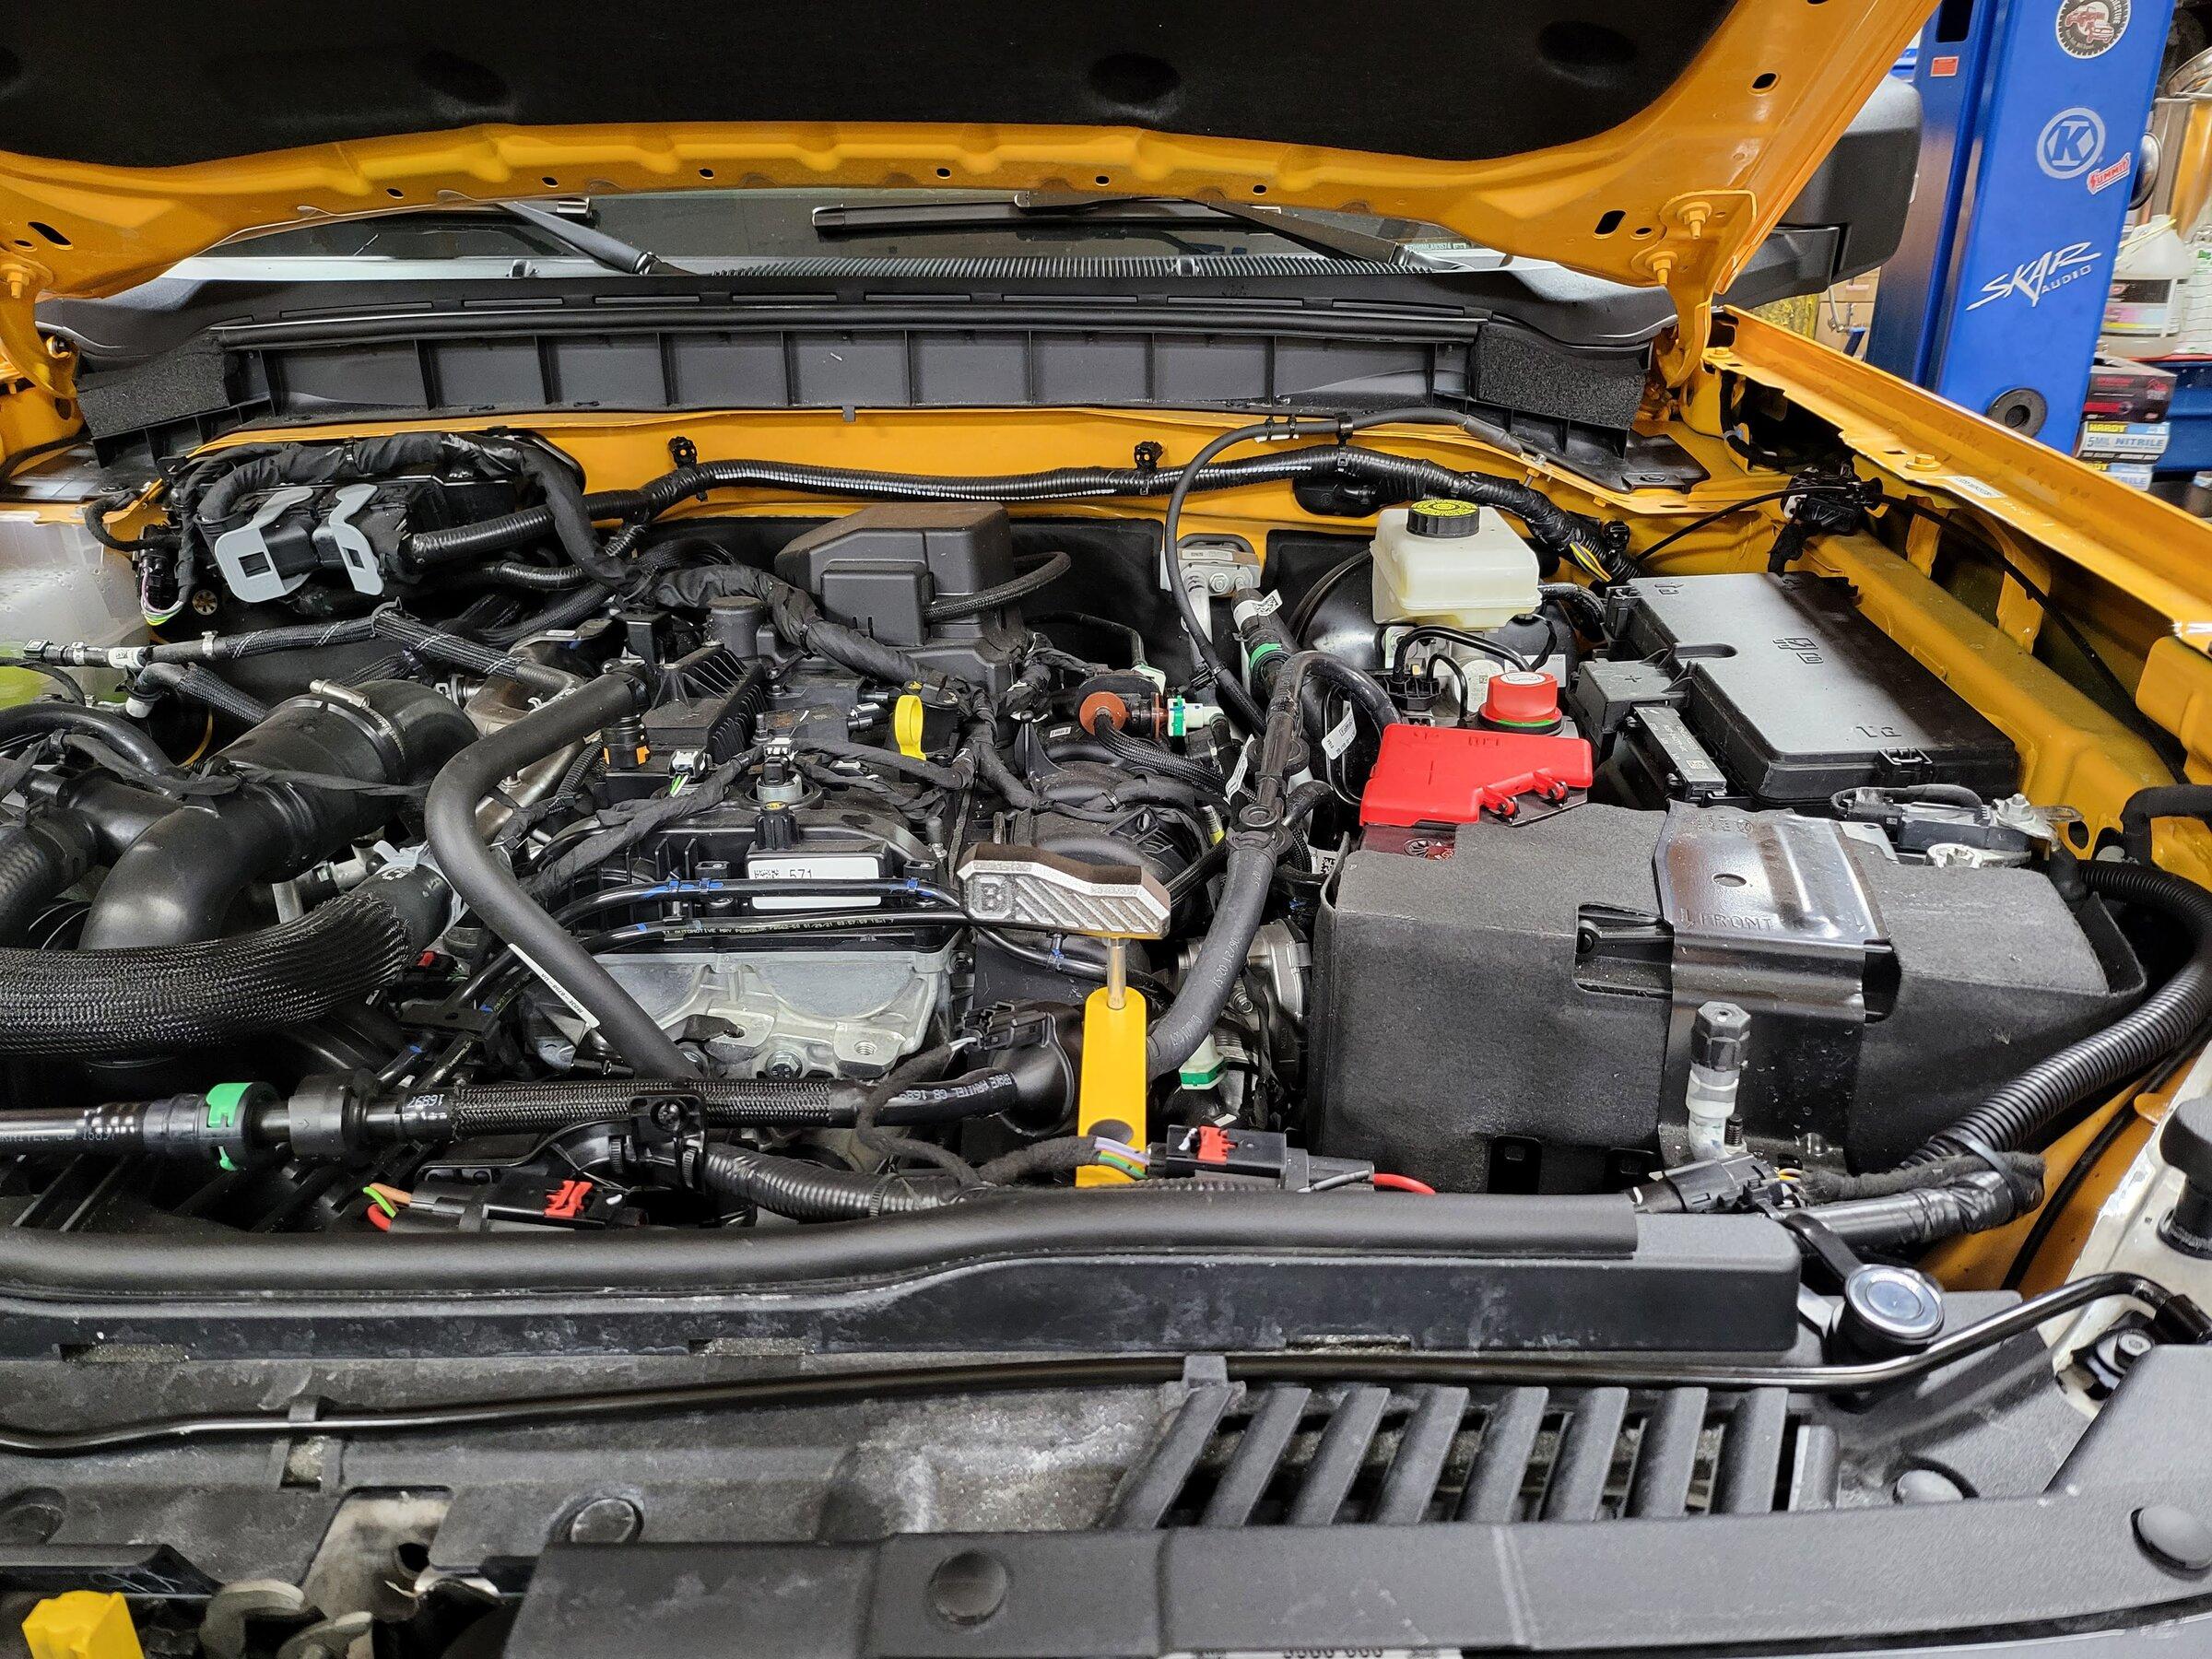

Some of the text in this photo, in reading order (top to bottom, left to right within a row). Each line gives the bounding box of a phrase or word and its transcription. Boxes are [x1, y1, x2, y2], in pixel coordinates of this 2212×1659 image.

[1965, 241, 2102, 311] SKAR
[2041, 265, 2092, 293] AUDIO
[2114, 437, 2164, 447] NITRILE
[1699, 912, 1771, 931] FRONT
[406, 1093, 446, 1108] 16897
